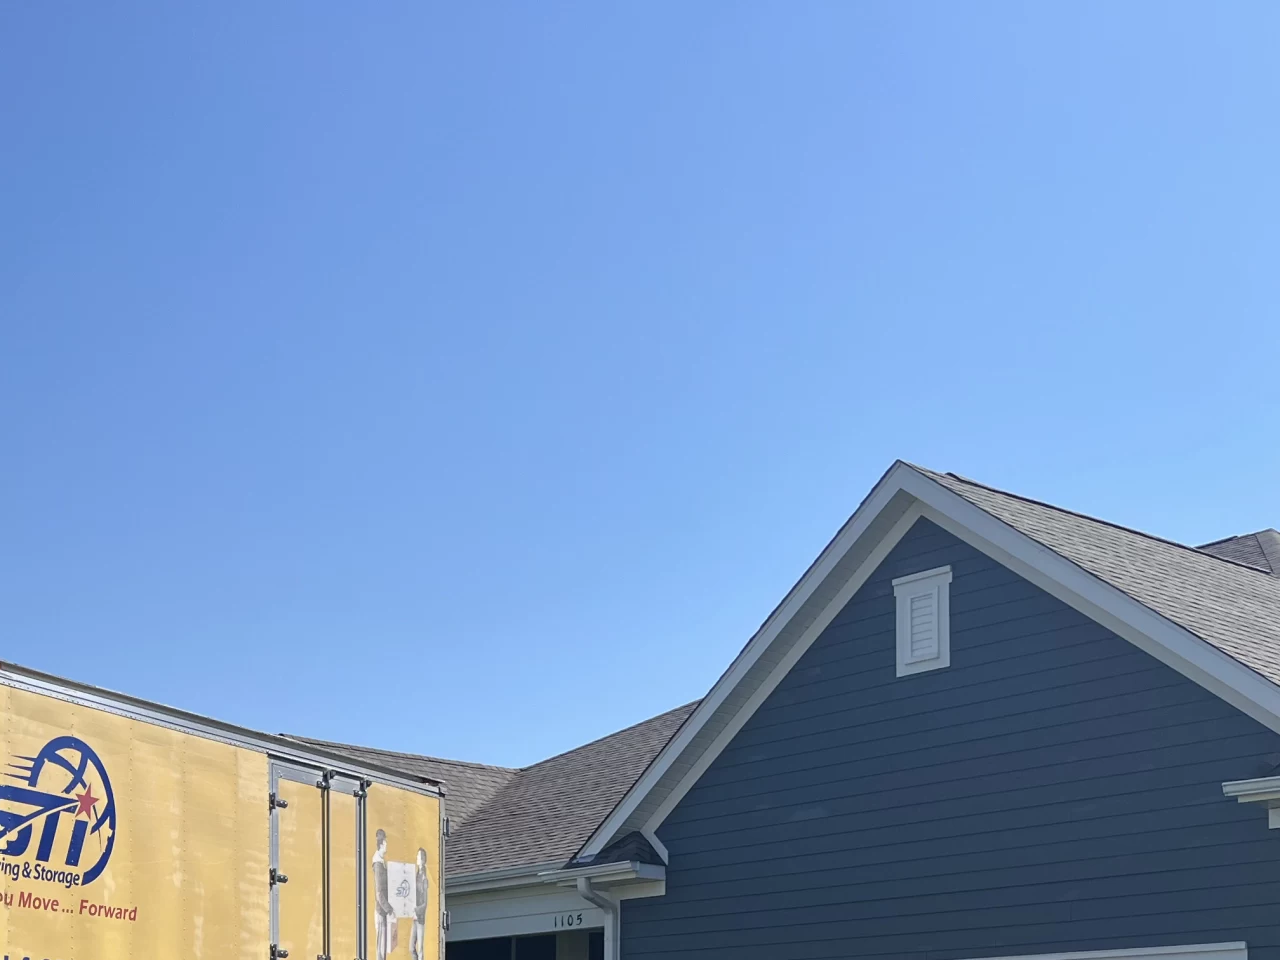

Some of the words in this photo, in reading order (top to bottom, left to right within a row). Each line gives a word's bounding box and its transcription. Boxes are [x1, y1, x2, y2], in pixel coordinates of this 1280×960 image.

[21, 861, 32, 879] &
[33, 863, 80, 888] Storage
[78, 899, 138, 922] Forward
[554, 913, 583, 928] 1105
